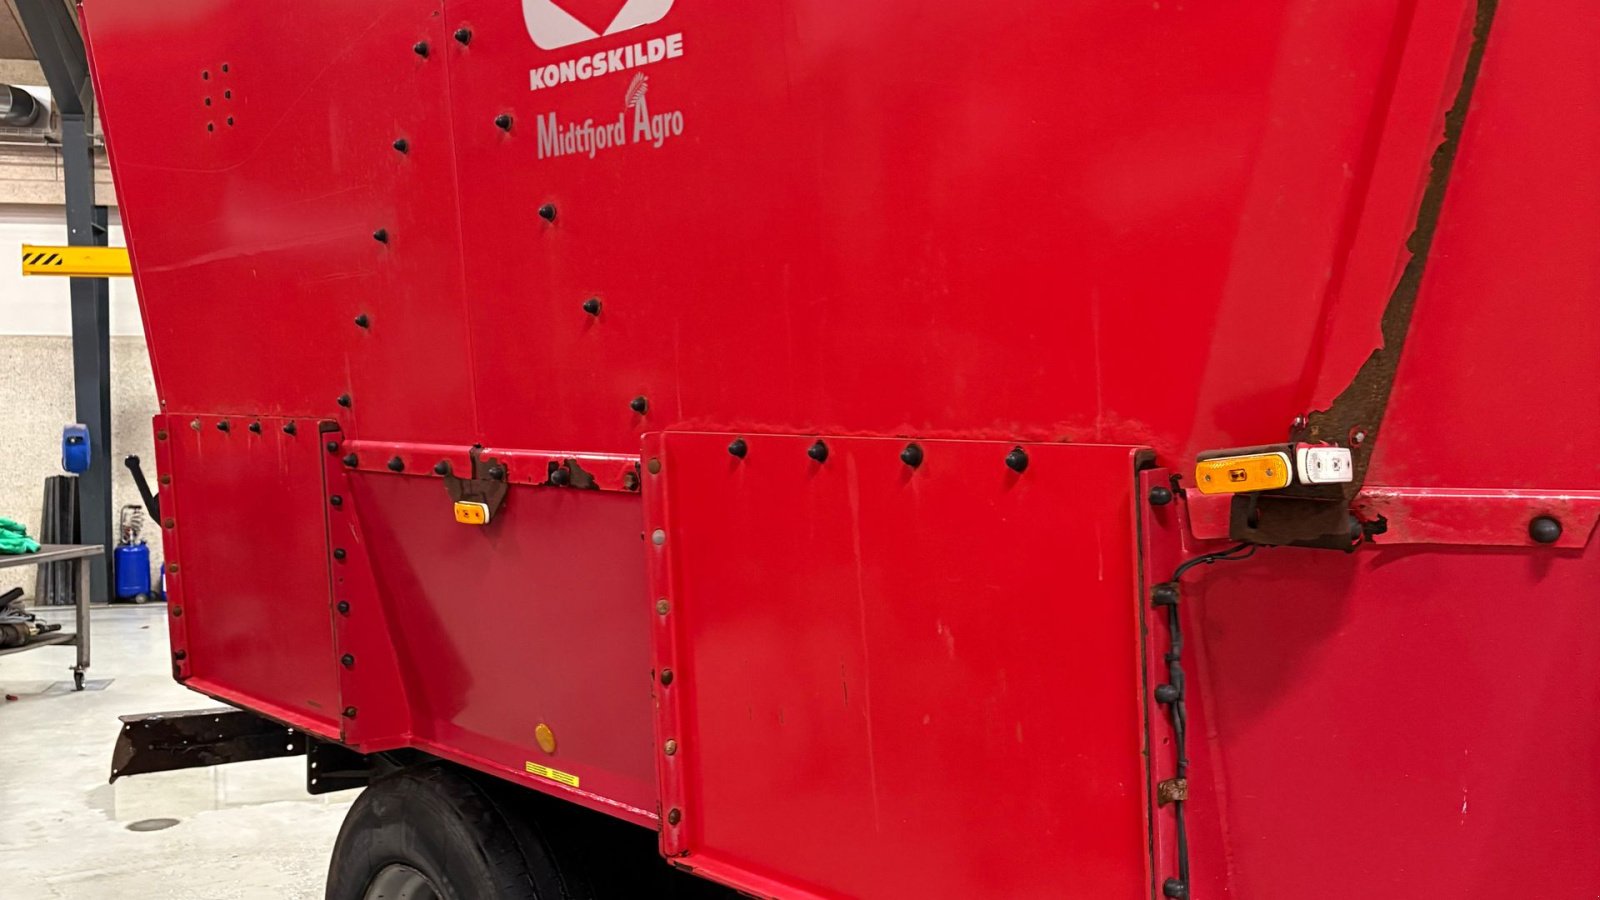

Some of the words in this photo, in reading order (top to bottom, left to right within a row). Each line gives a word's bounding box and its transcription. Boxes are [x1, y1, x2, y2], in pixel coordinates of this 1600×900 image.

[529, 32, 684, 91] KONGSKILDE
[536, 111, 626, 160] Midtfjord
[633, 90, 685, 149] Agro
